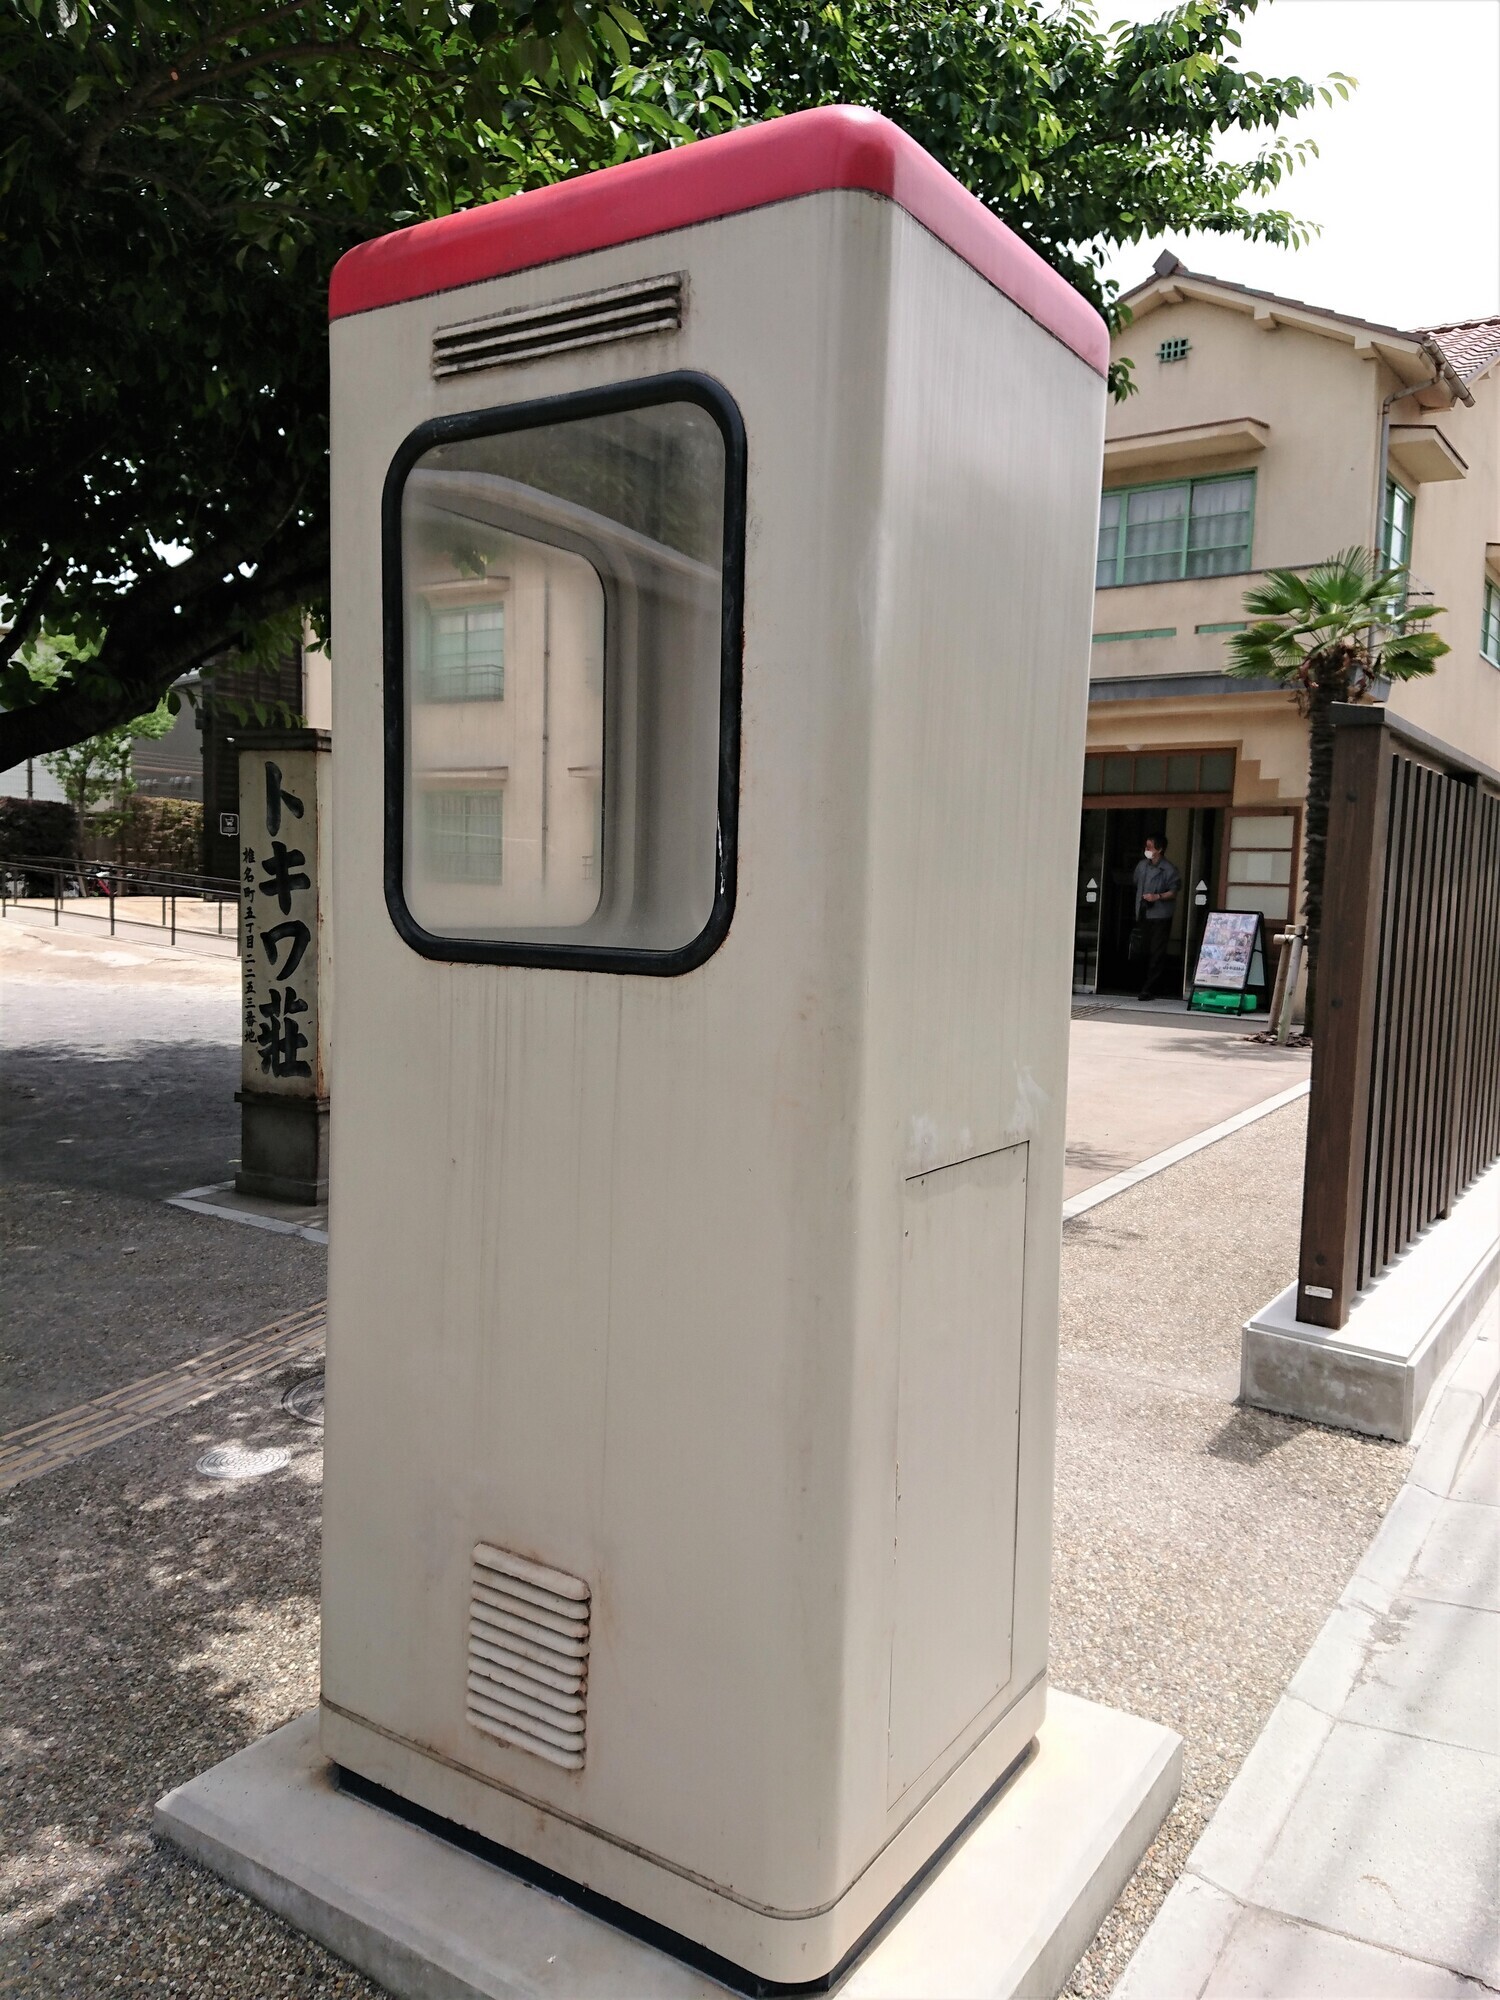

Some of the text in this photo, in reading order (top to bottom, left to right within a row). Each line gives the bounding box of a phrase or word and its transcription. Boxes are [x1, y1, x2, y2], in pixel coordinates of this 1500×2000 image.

[242, 847, 257, 1043] 椎名町五丁目二二五三番地
